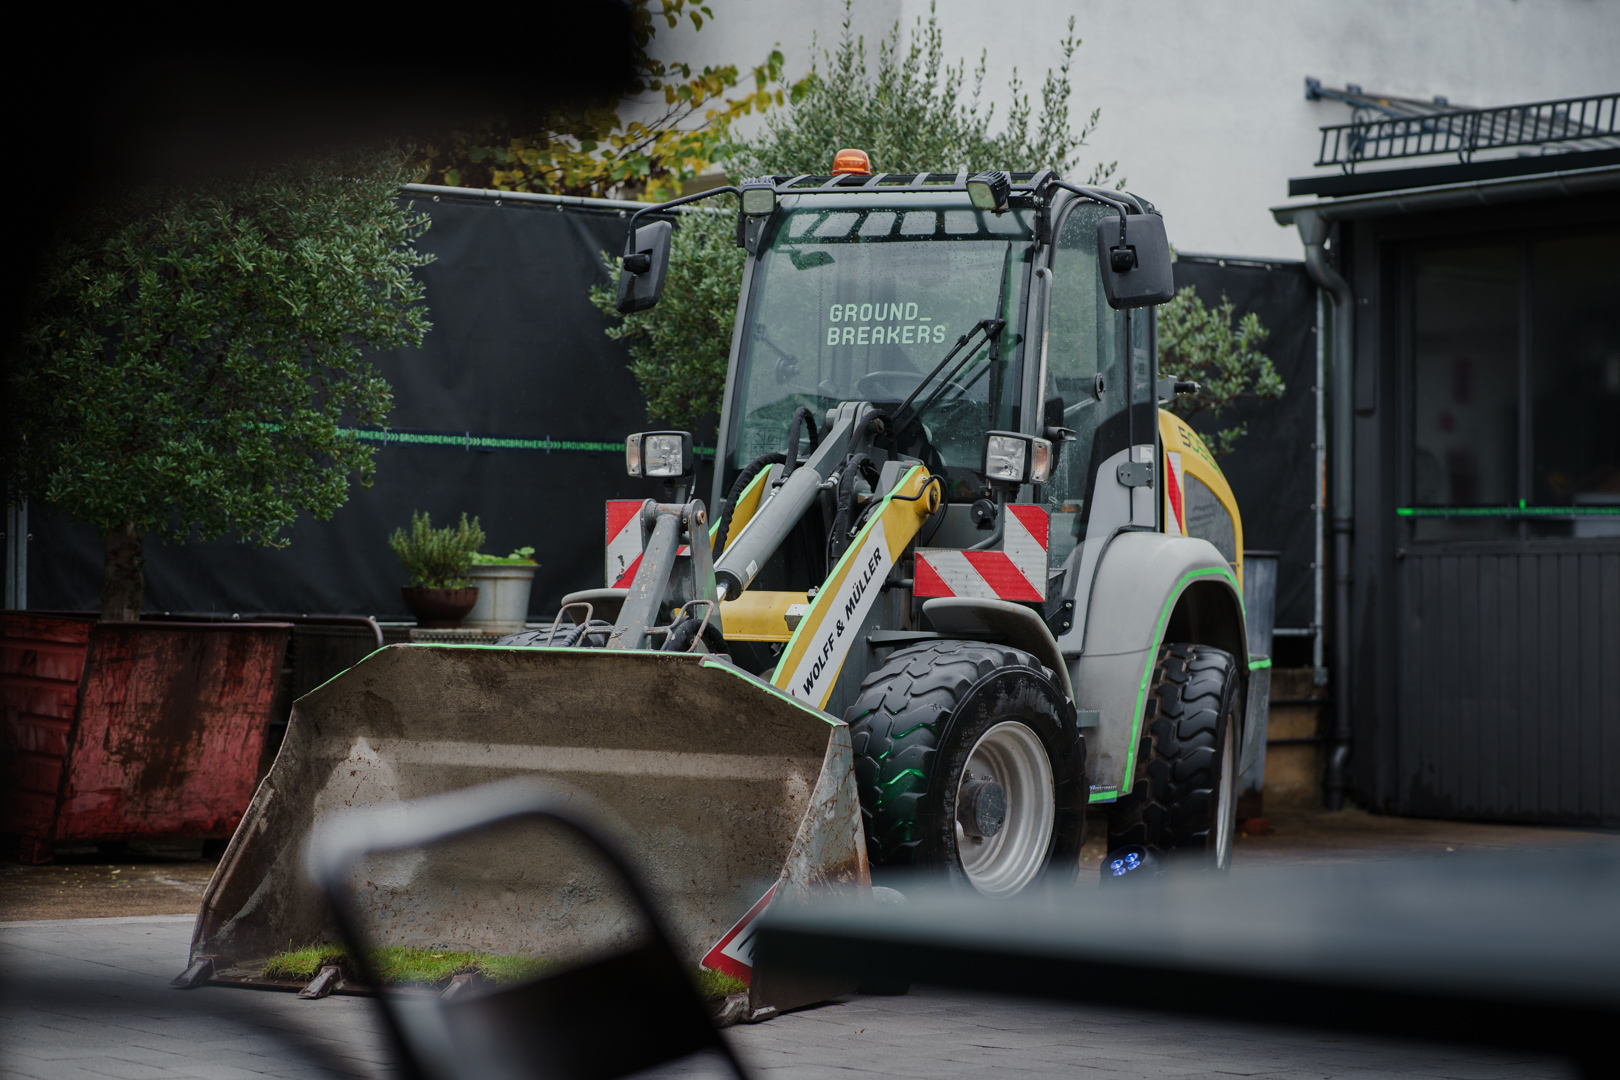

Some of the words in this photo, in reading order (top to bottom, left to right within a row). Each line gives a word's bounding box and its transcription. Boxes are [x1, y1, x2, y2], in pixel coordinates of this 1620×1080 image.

[829, 302, 932, 322] GROUND_
[827, 324, 946, 346] BREAKERS
[803, 633, 835, 696] WOLFF
[836, 619, 846, 638] &
[845, 547, 882, 620] MÜLLER
